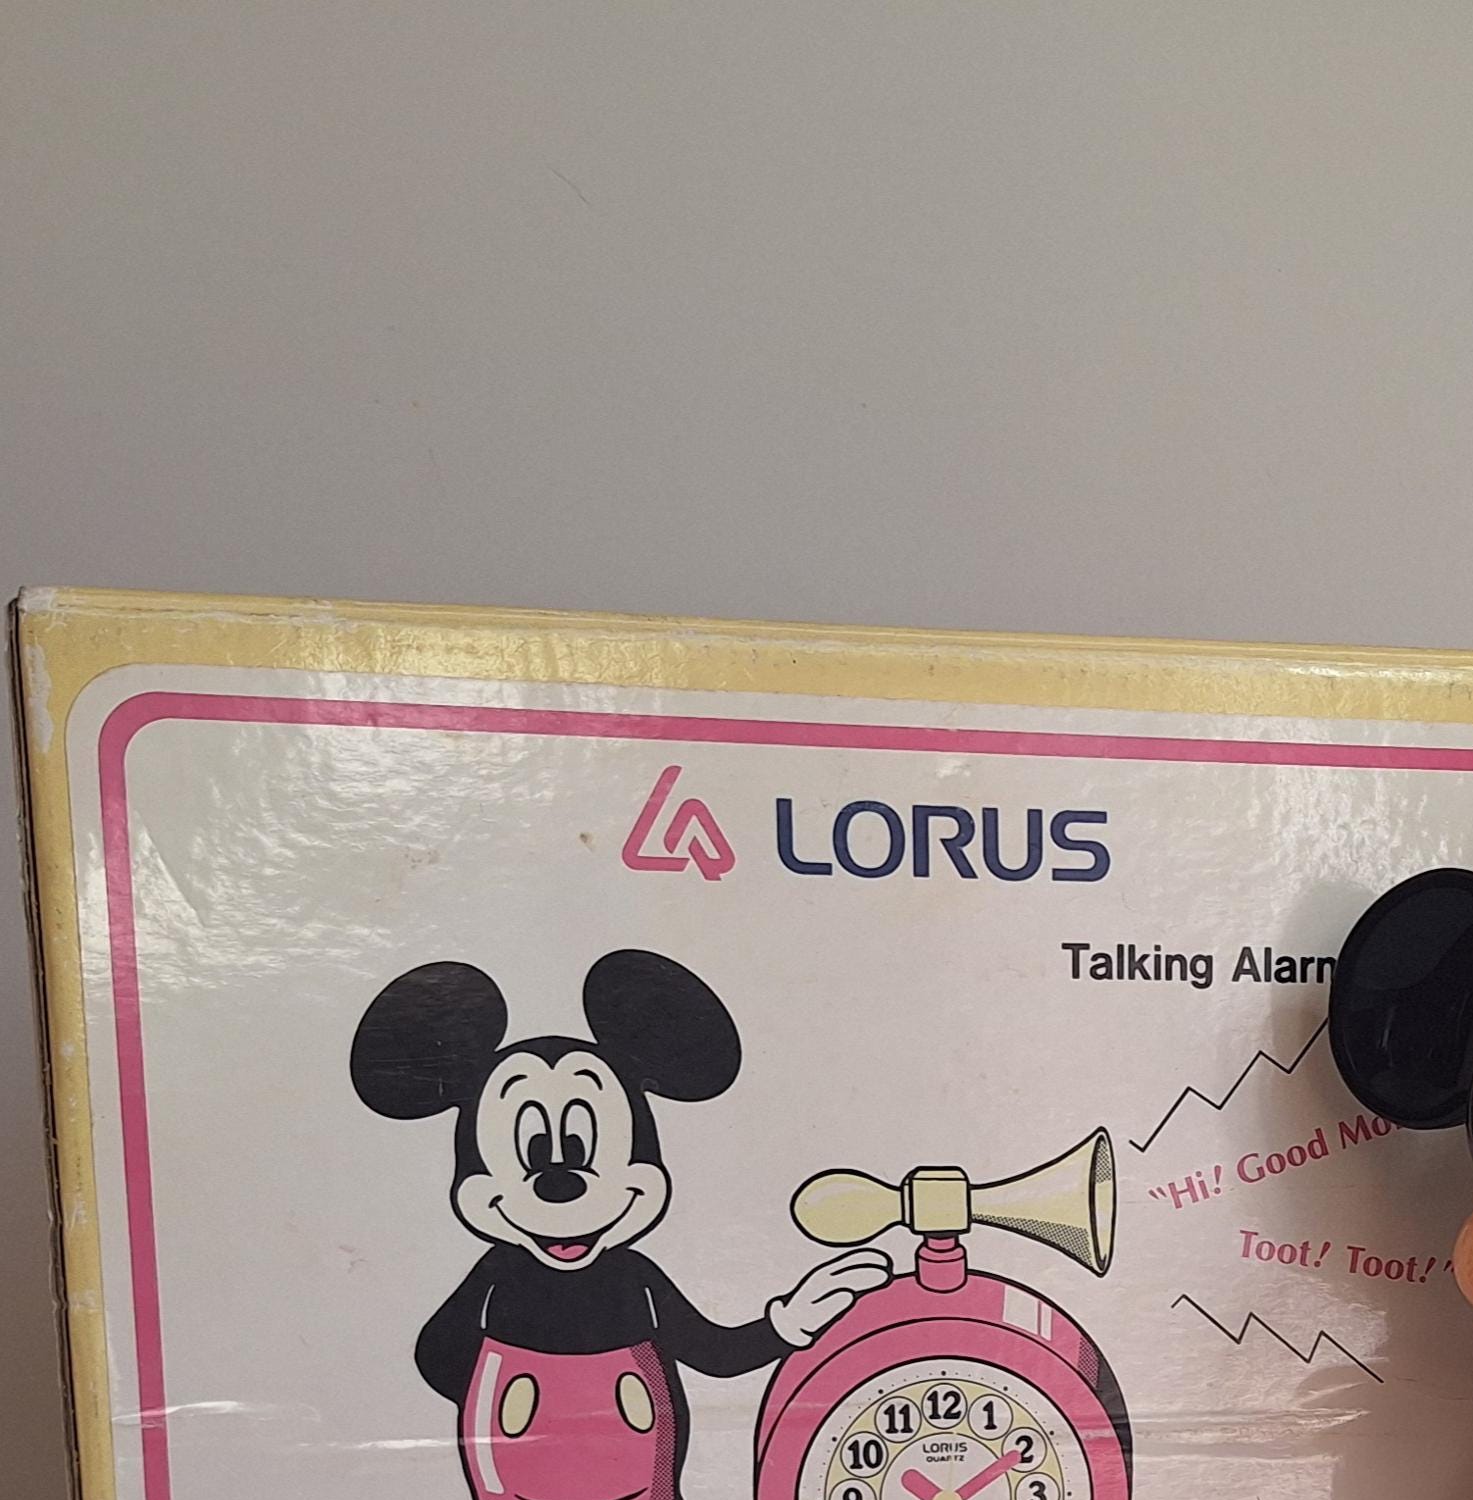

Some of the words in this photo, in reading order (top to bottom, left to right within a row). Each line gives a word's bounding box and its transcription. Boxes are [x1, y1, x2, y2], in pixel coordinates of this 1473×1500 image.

[775, 797, 1113, 883] LORUS
[1061, 942, 1214, 989] Talking
[1236, 1128, 1329, 1184] Good
[1239, 1229, 1332, 1268] Toot!
[883, 1403, 914, 1434] 11
[927, 1390, 962, 1420] 12
[983, 1401, 998, 1430] 1
[847, 1439, 884, 1469] 10
[1015, 1435, 1034, 1464] 2
